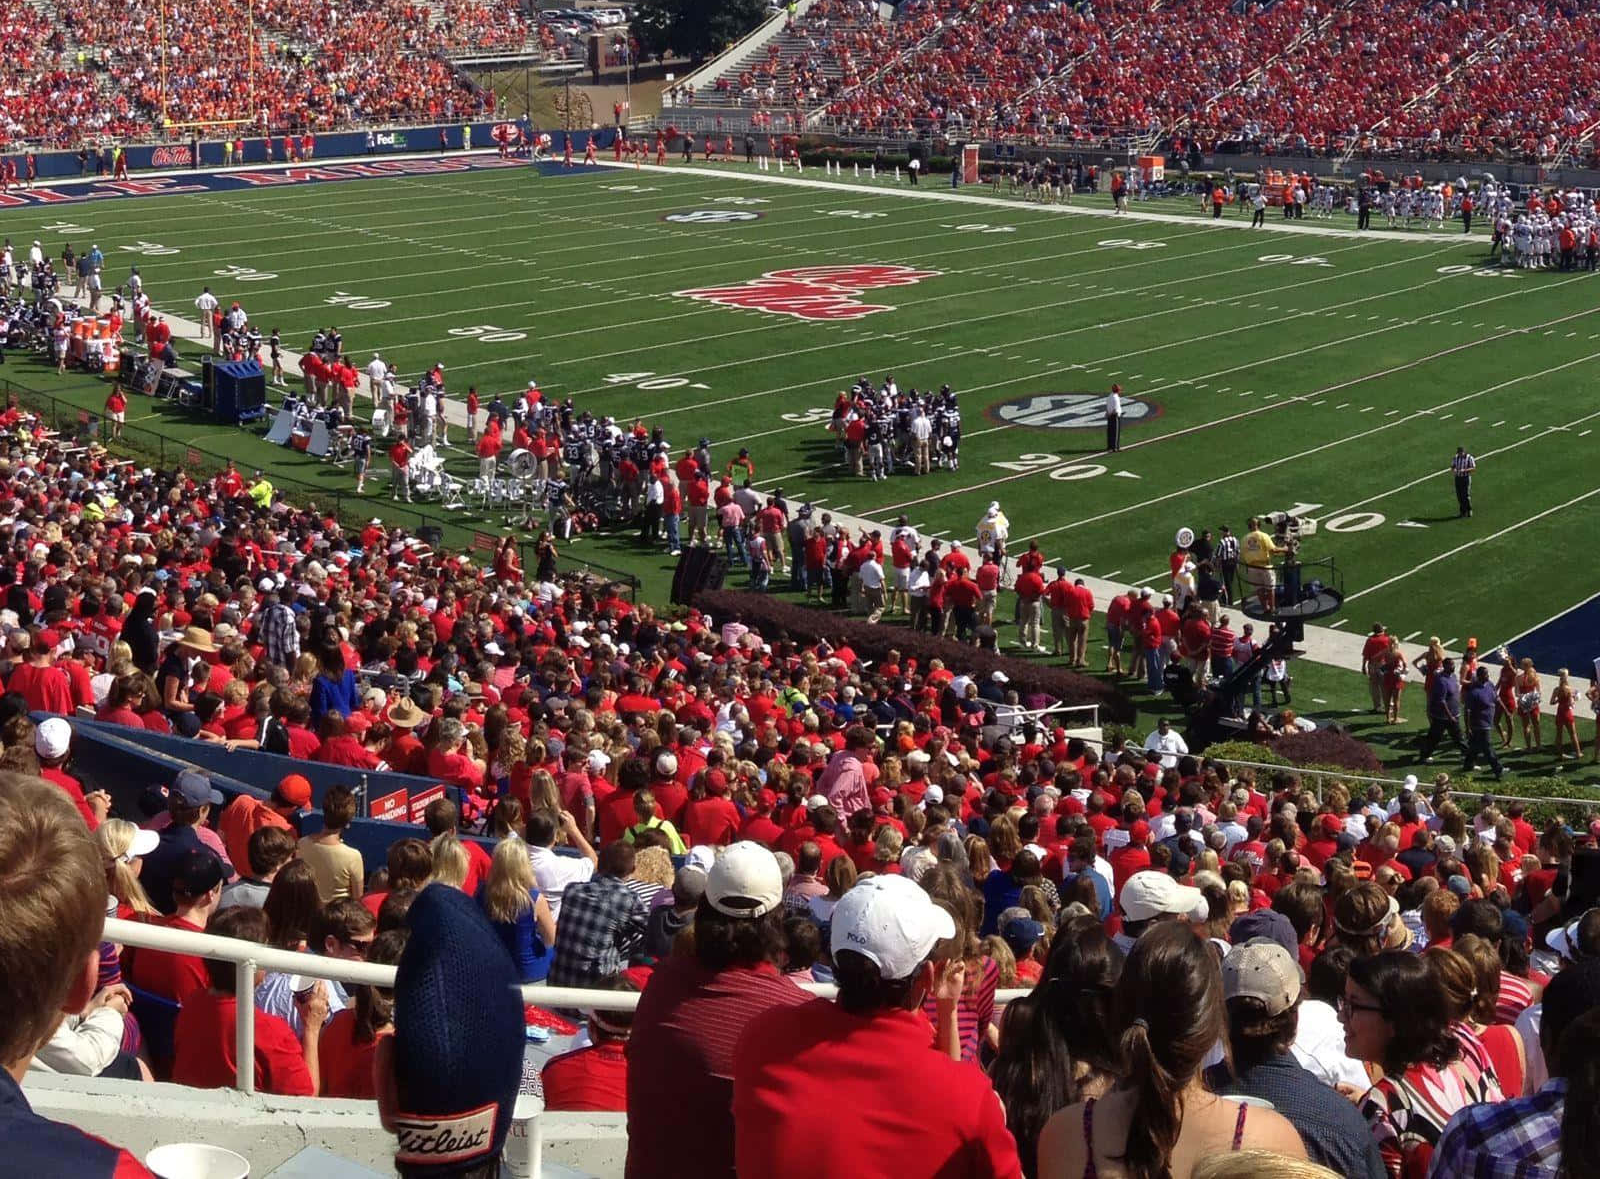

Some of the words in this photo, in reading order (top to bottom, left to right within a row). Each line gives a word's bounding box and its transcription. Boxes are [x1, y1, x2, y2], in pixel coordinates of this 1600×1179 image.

[377, 132, 407, 146] FedEx
[152, 147, 172, 166] Ole
[220, 155, 536, 186] MISS
[120, 241, 181, 255] 20
[213, 264, 279, 282] 30
[323, 291, 393, 310] 40
[448, 324, 528, 342] 50
[602, 371, 690, 390] 40
[990, 452, 1108, 482] 20
[384, 798, 396, 811] NO
[847, 932, 866, 945] POLO
[396, 1121, 489, 1155] Titleist
